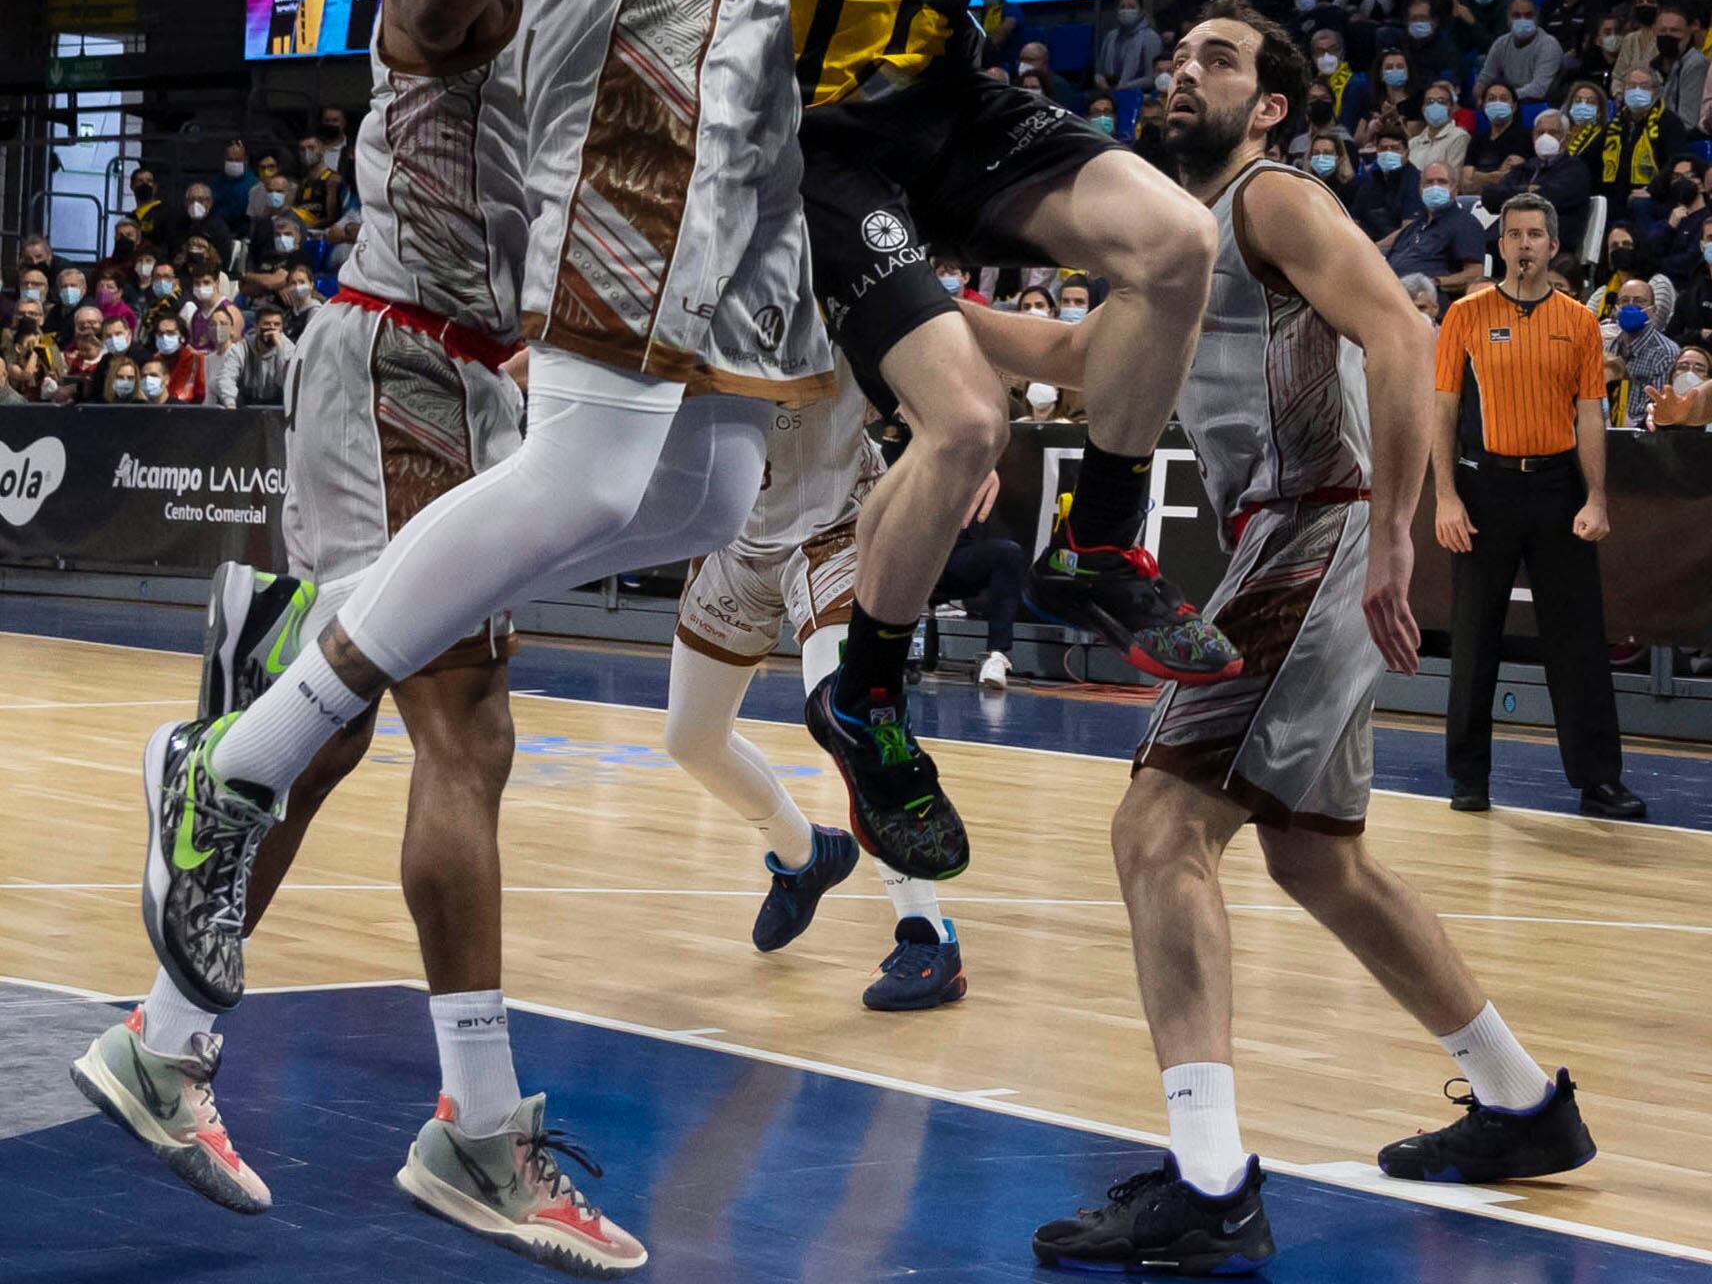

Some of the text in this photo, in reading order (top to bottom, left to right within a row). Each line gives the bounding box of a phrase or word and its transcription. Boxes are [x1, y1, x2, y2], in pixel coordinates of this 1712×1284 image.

[852, 275, 876, 299] LA
[112, 452, 202, 496] Alcampo
[165, 502, 266, 524] Centro Comercial
[697, 596, 753, 633] LEXUS
